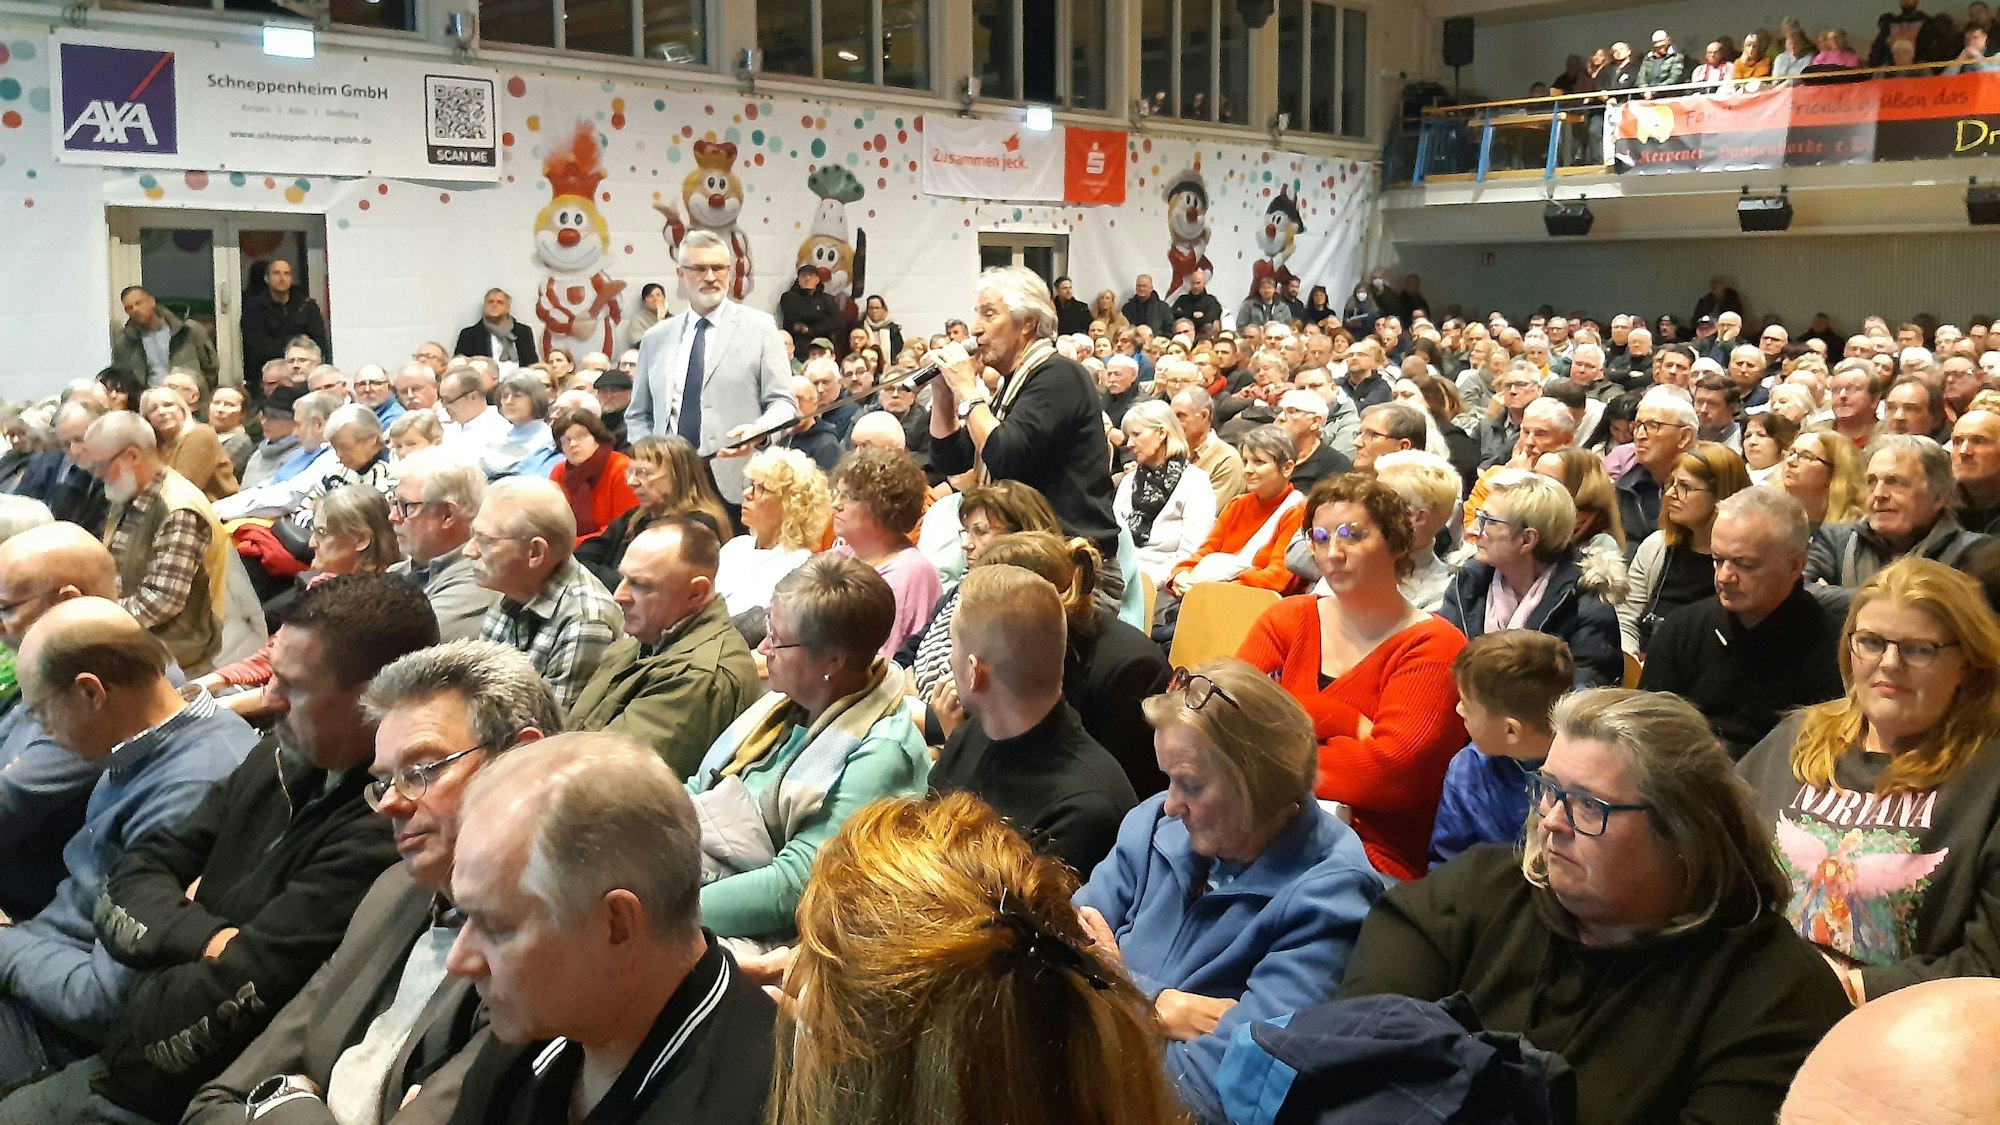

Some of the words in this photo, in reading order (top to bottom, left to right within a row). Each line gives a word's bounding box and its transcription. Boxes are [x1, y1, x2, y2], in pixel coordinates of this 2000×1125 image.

[206, 73, 338, 98] Schneppenheim
[340, 84, 389, 101] GmbH
[1933, 88, 1969, 106] das
[64, 100, 158, 146] AXA
[435, 149, 466, 162] SCAN
[468, 151, 488, 164] ME
[932, 148, 1000, 168] Zusammen
[1001, 154, 1030, 172] jeck.
[1789, 782, 1938, 830] NIRVANA
